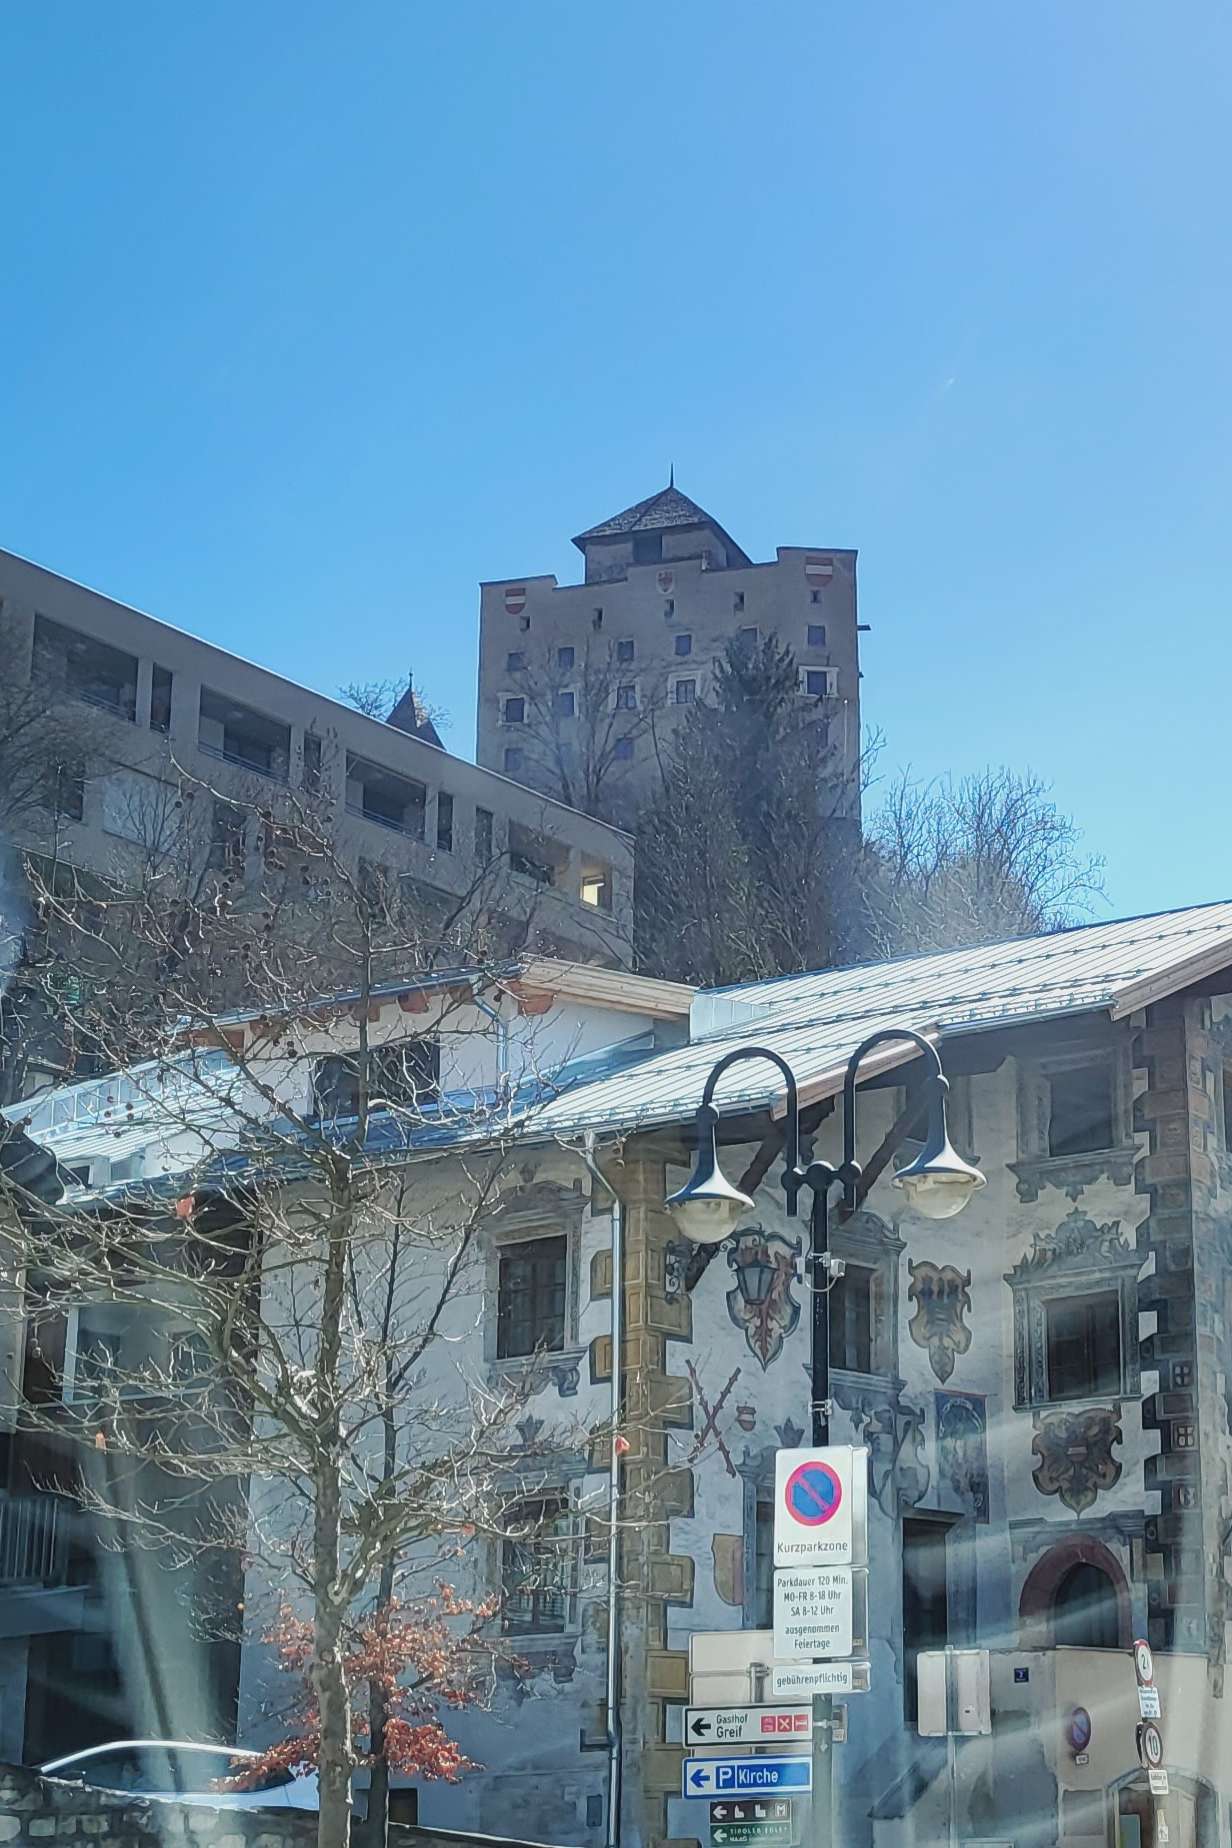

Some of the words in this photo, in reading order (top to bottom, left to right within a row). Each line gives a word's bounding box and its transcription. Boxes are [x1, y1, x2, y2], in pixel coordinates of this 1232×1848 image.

[777, 1541, 848, 1555] Kurzparkzone
[777, 1576, 816, 1587] Parkdauer
[818, 1575, 830, 1585] 120
[832, 1575, 849, 1585] Min.
[783, 1592, 808, 1602] MO-FR
[809, 1591, 826, 1601] 8-18
[828, 1590, 842, 1600] Uhr
[791, 1606, 801, 1617] SA
[802, 1606, 819, 1617] 8-12
[820, 1605, 835, 1615] Uhr
[785, 1624, 840, 1636] ausgenommen
[794, 1639, 832, 1650] Feiertage
[776, 1671, 848, 1687] gebührenpflichtig
[716, 1713, 748, 1724] Gasthof
[716, 1726, 743, 1738] Greif
[719, 1767, 733, 1787] P
[739, 1767, 779, 1784] Kirche
